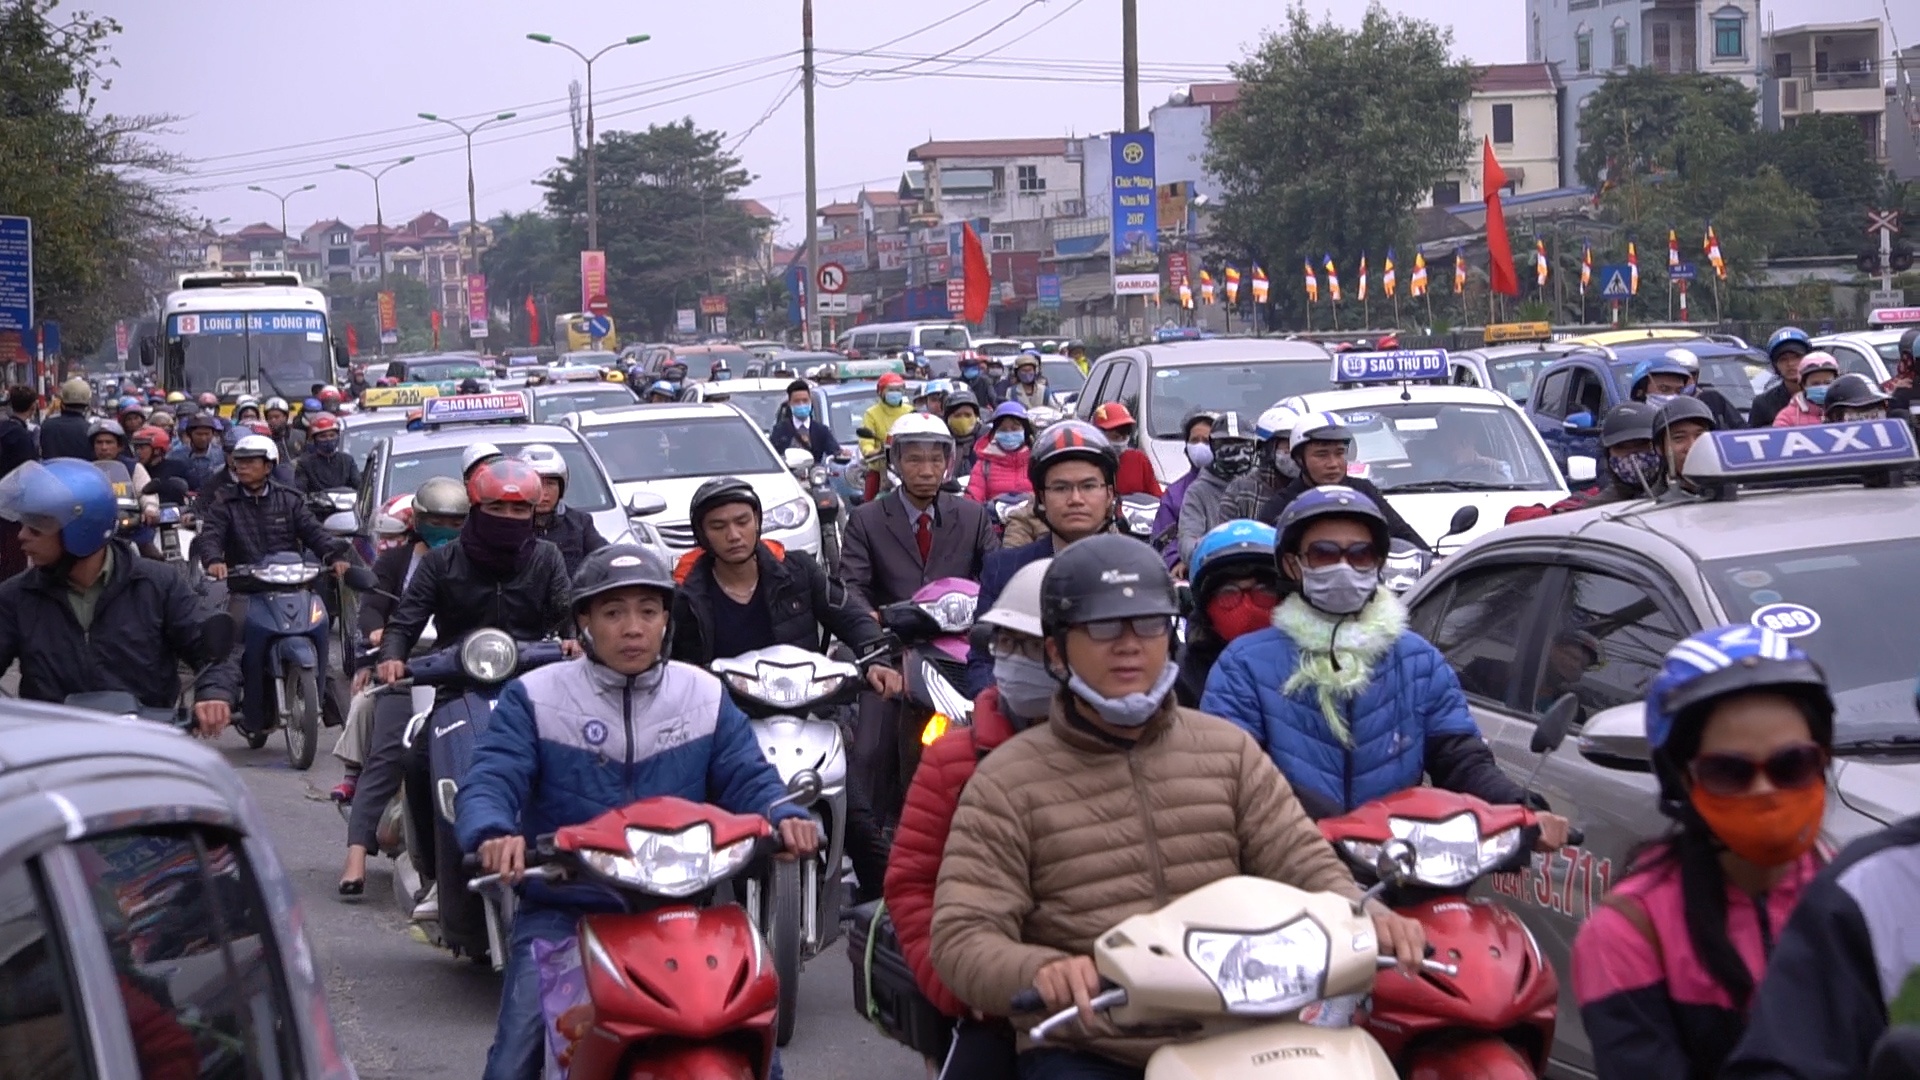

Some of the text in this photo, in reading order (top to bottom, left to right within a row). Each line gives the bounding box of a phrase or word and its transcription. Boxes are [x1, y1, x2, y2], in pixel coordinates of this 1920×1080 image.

[1127, 212, 1144, 226] 2017
[1116, 280, 1158, 290] GAMUDA
[182, 317, 196, 332] 8
[203, 317, 232, 330] LONG
[1369, 358, 1395, 373] SAO
[1733, 423, 1893, 461] TAXI
